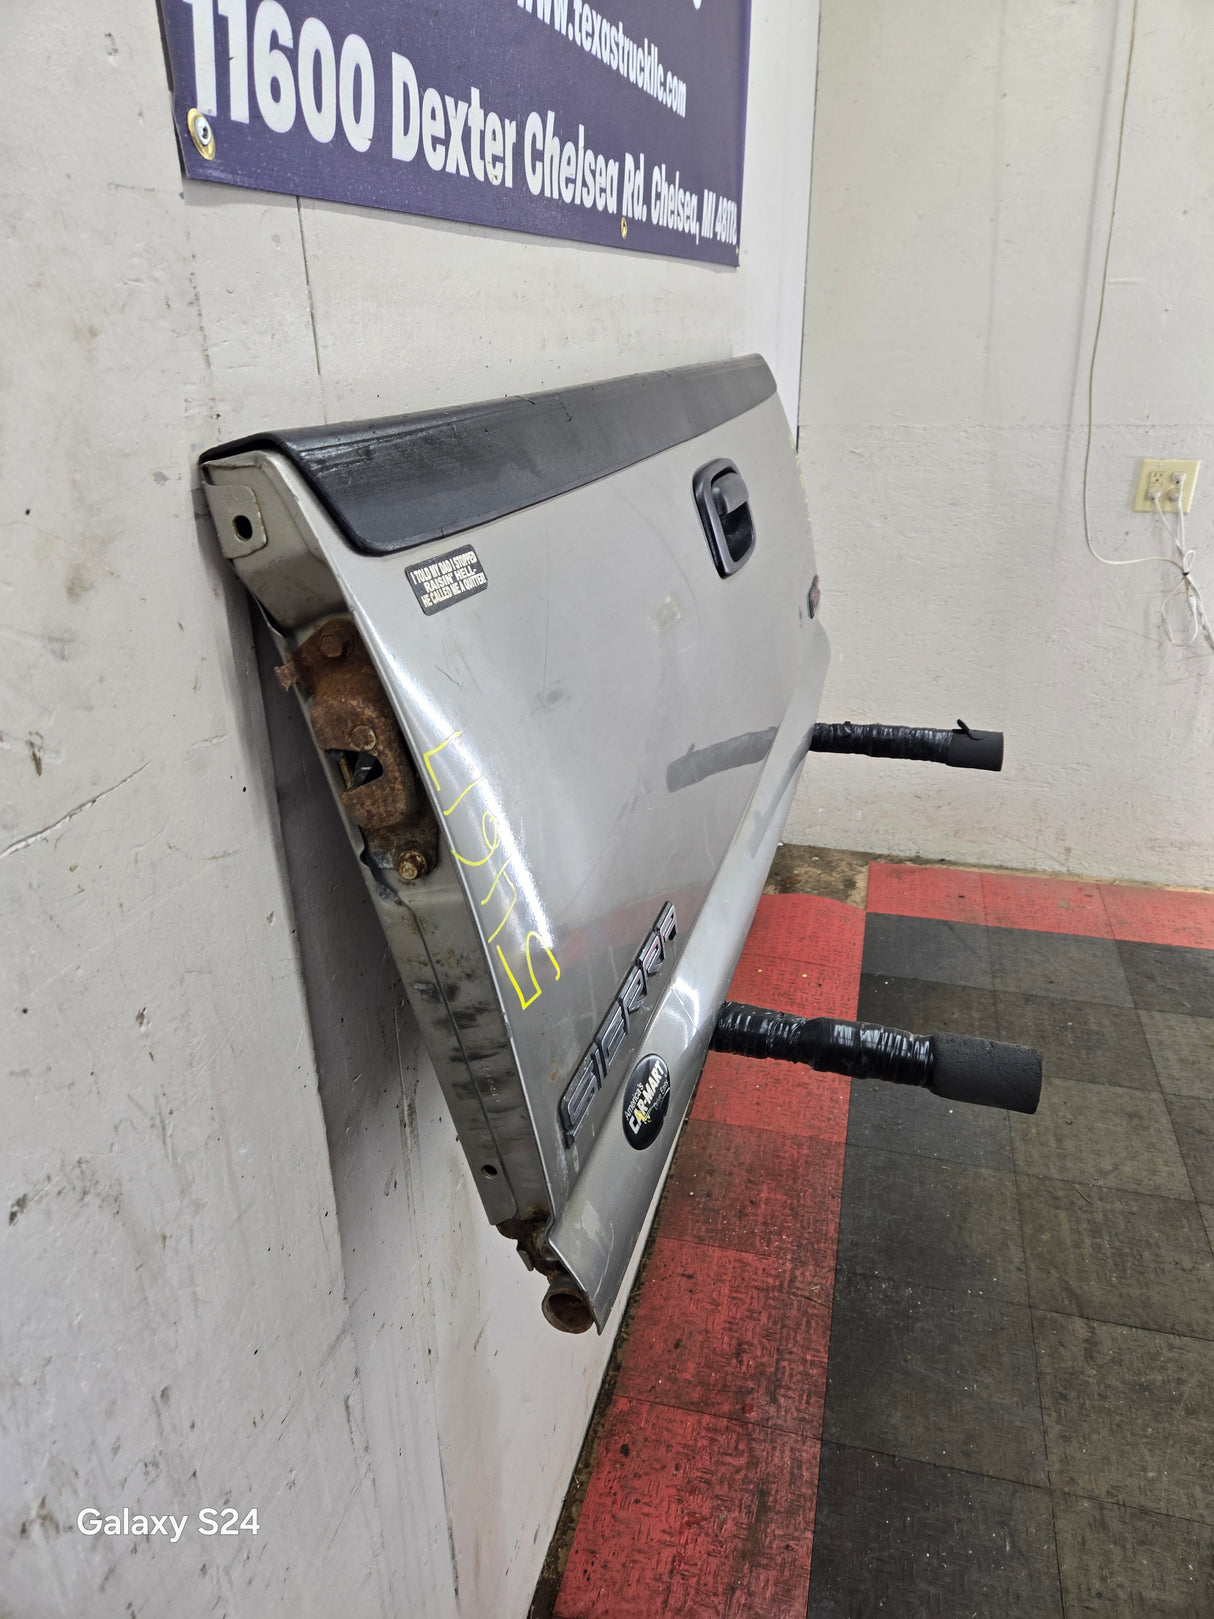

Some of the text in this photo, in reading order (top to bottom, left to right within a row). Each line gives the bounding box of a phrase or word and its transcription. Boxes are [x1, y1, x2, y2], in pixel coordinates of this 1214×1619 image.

[517, 0, 687, 118] w.texastruckllc.com
[182, 0, 375, 152] 11600
[391, 52, 516, 188] Dexter
[524, 110, 619, 214] Chelsea
[622, 152, 647, 222] Rd.
[651, 163, 700, 245] Chelsea,
[701, 189, 716, 239] MI
[410, 551, 477, 584] I TOLD MY DAD I STOPPED
[421, 594, 433, 607] HE
[430, 587, 452, 604] CALLED
[450, 583, 461, 596] ME
[459, 581, 466, 592] A
[424, 573, 453, 593] RAISIN'
[557, 900, 679, 1149] SIERRA
[624, 1082, 644, 1120] America's
[629, 1060, 665, 1134] CAR-MART
